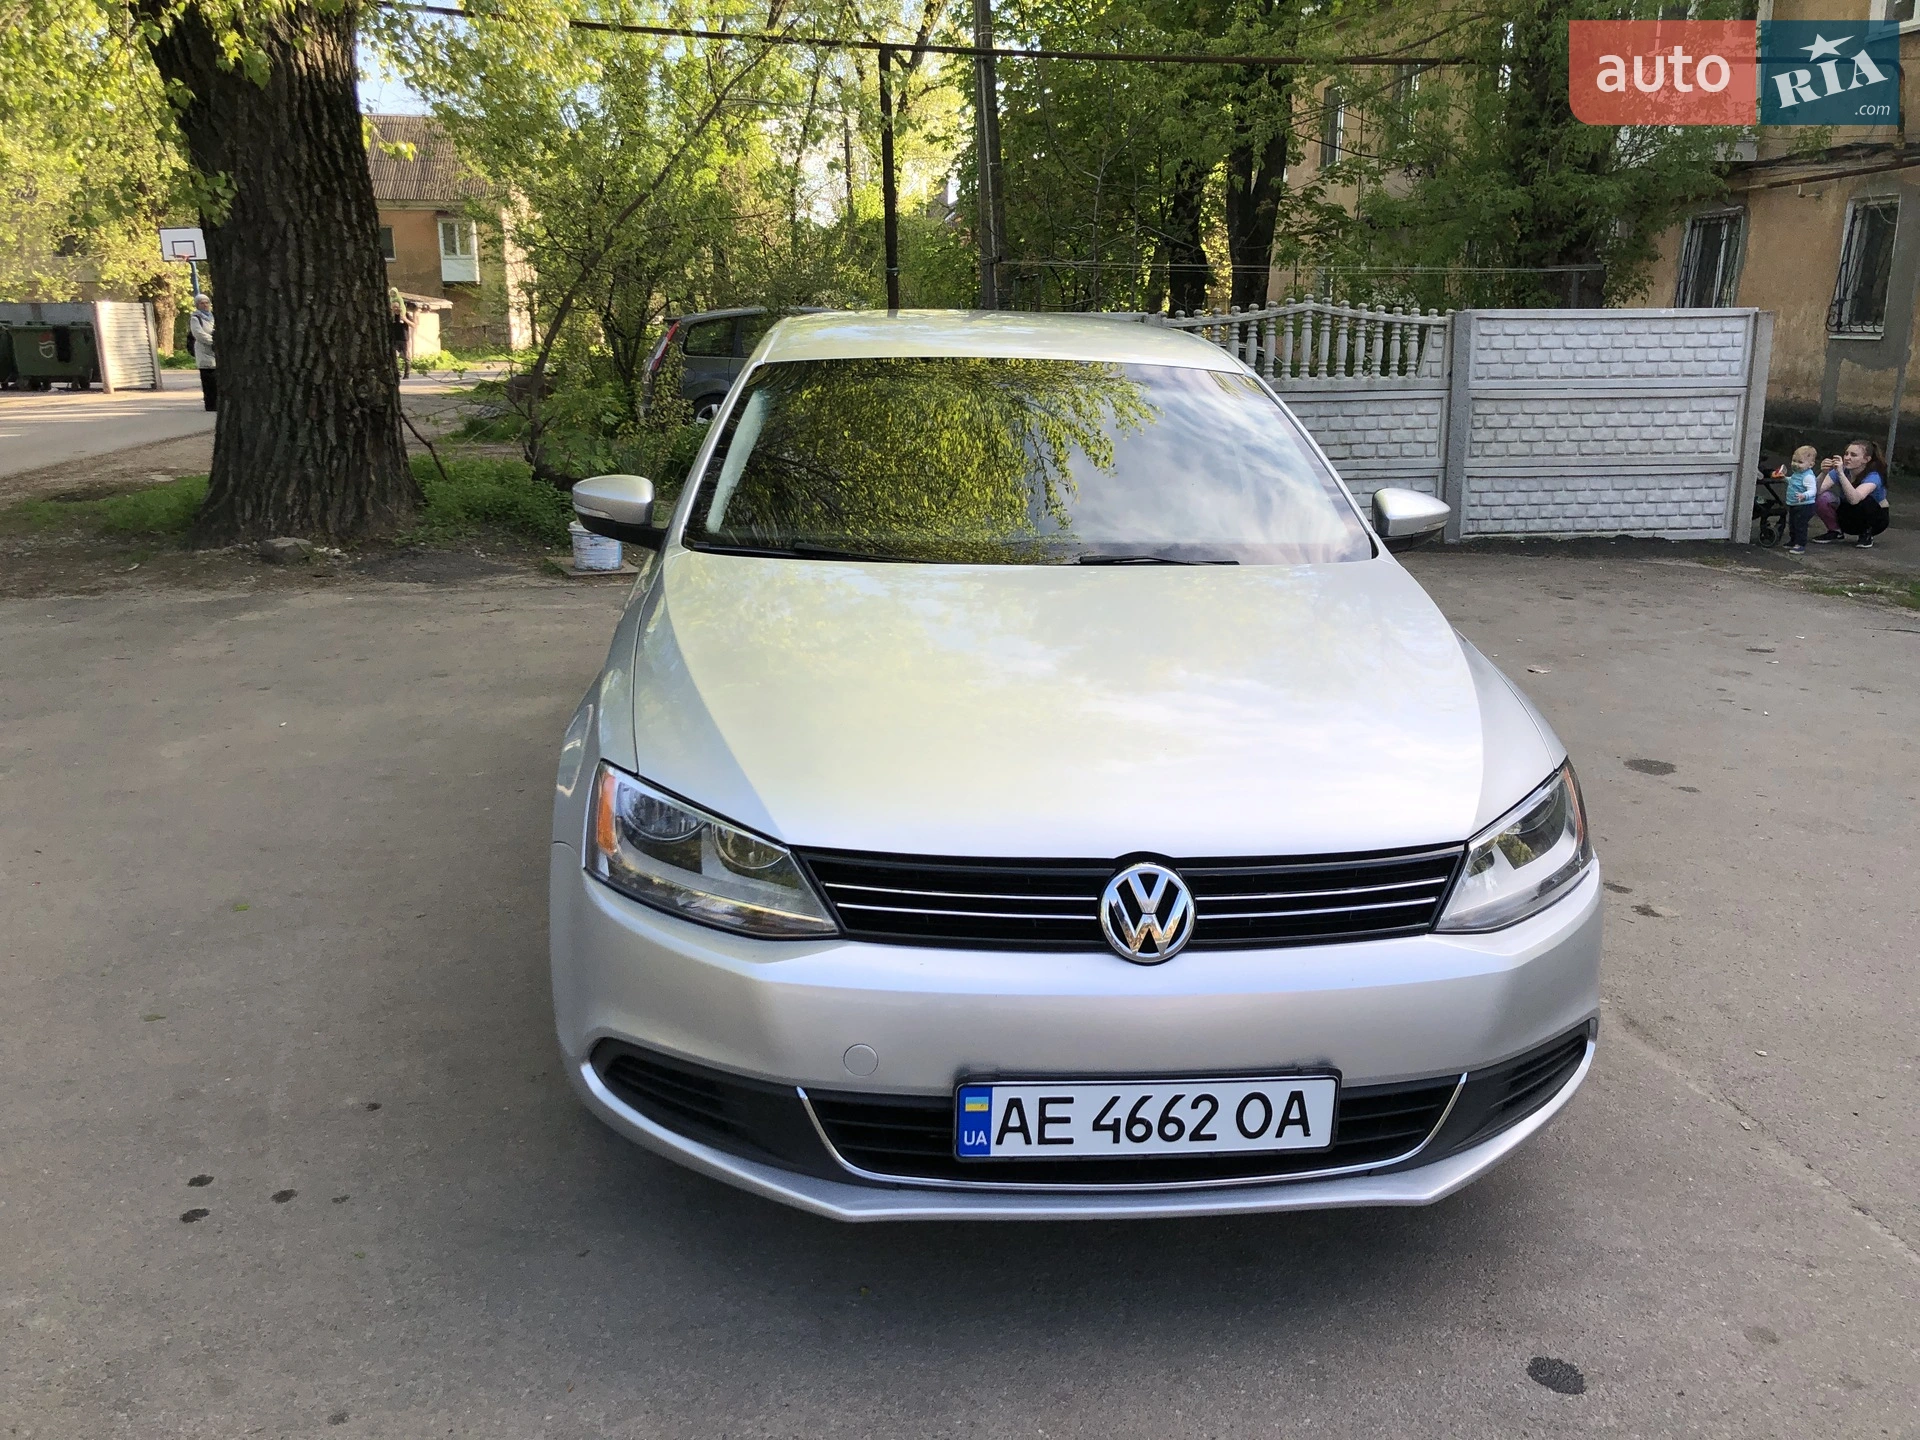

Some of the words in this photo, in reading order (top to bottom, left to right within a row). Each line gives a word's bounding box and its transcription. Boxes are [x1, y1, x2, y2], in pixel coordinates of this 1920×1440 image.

[995, 1096, 1075, 1146] AE
[1092, 1093, 1220, 1144] 4662
[1235, 1089, 1312, 1140] OA
[964, 1130, 988, 1147] UA
